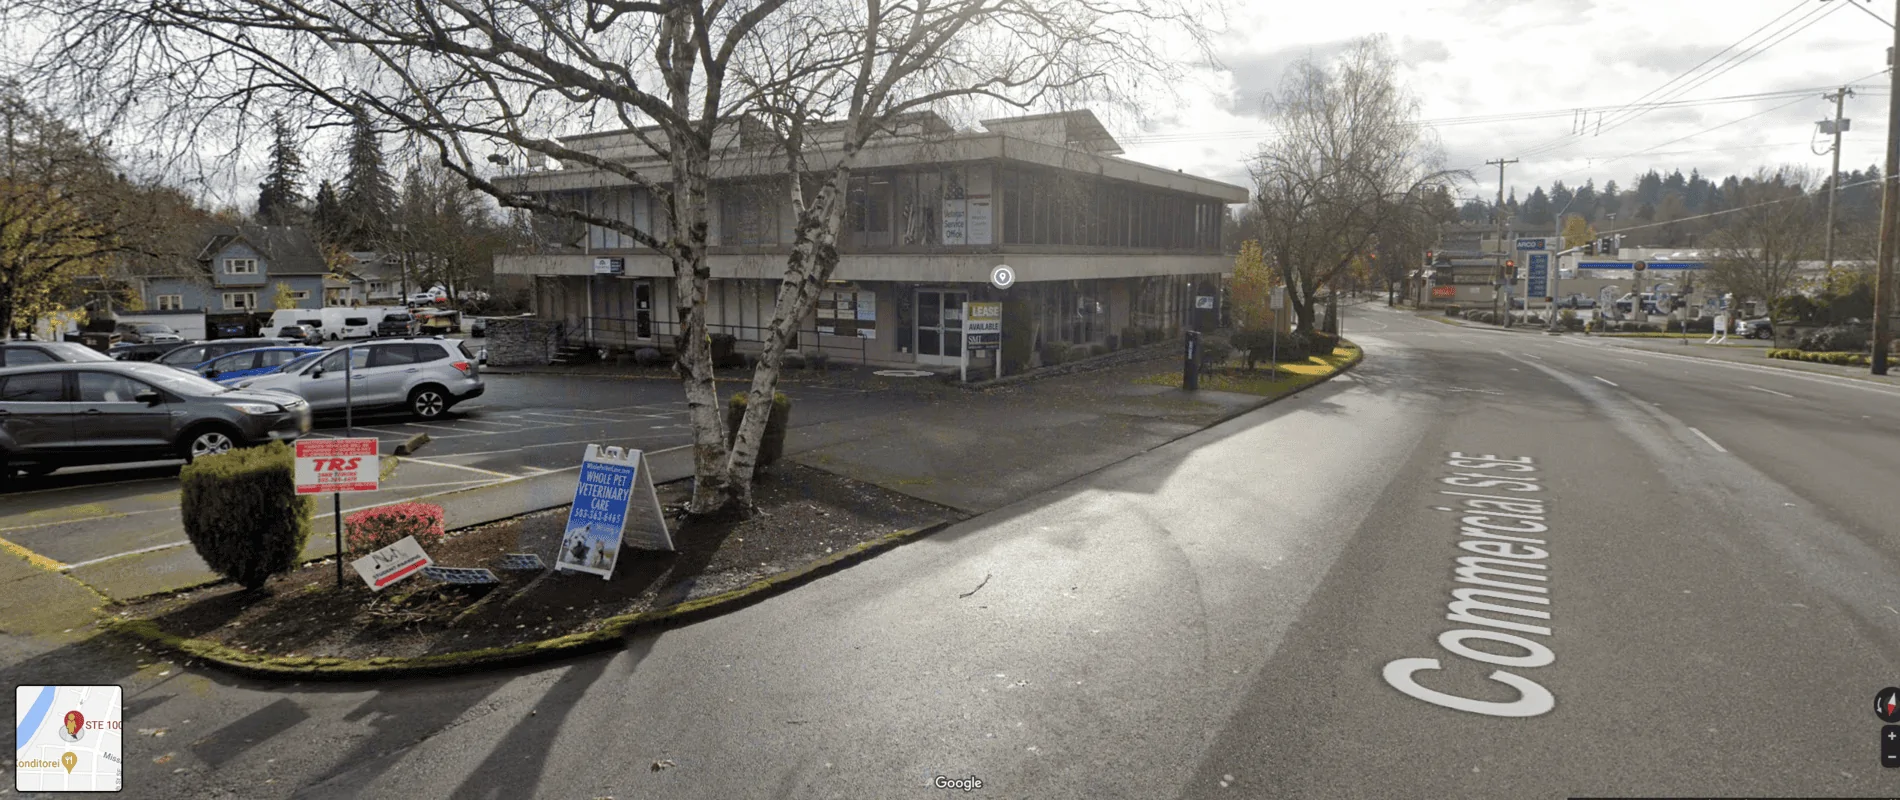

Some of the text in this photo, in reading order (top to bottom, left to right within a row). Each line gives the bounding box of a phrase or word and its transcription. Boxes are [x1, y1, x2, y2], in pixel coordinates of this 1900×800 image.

[944, 220, 965, 228] Service
[946, 230, 963, 239] Office
[972, 305, 1000, 317] LEASE
[968, 322, 999, 331] AVAILABLE
[312, 457, 362, 472] TRS
[587, 471, 628, 487] WHOLE PET
[579, 482, 629, 501] VETERINARY
[591, 497, 610, 511] CARE
